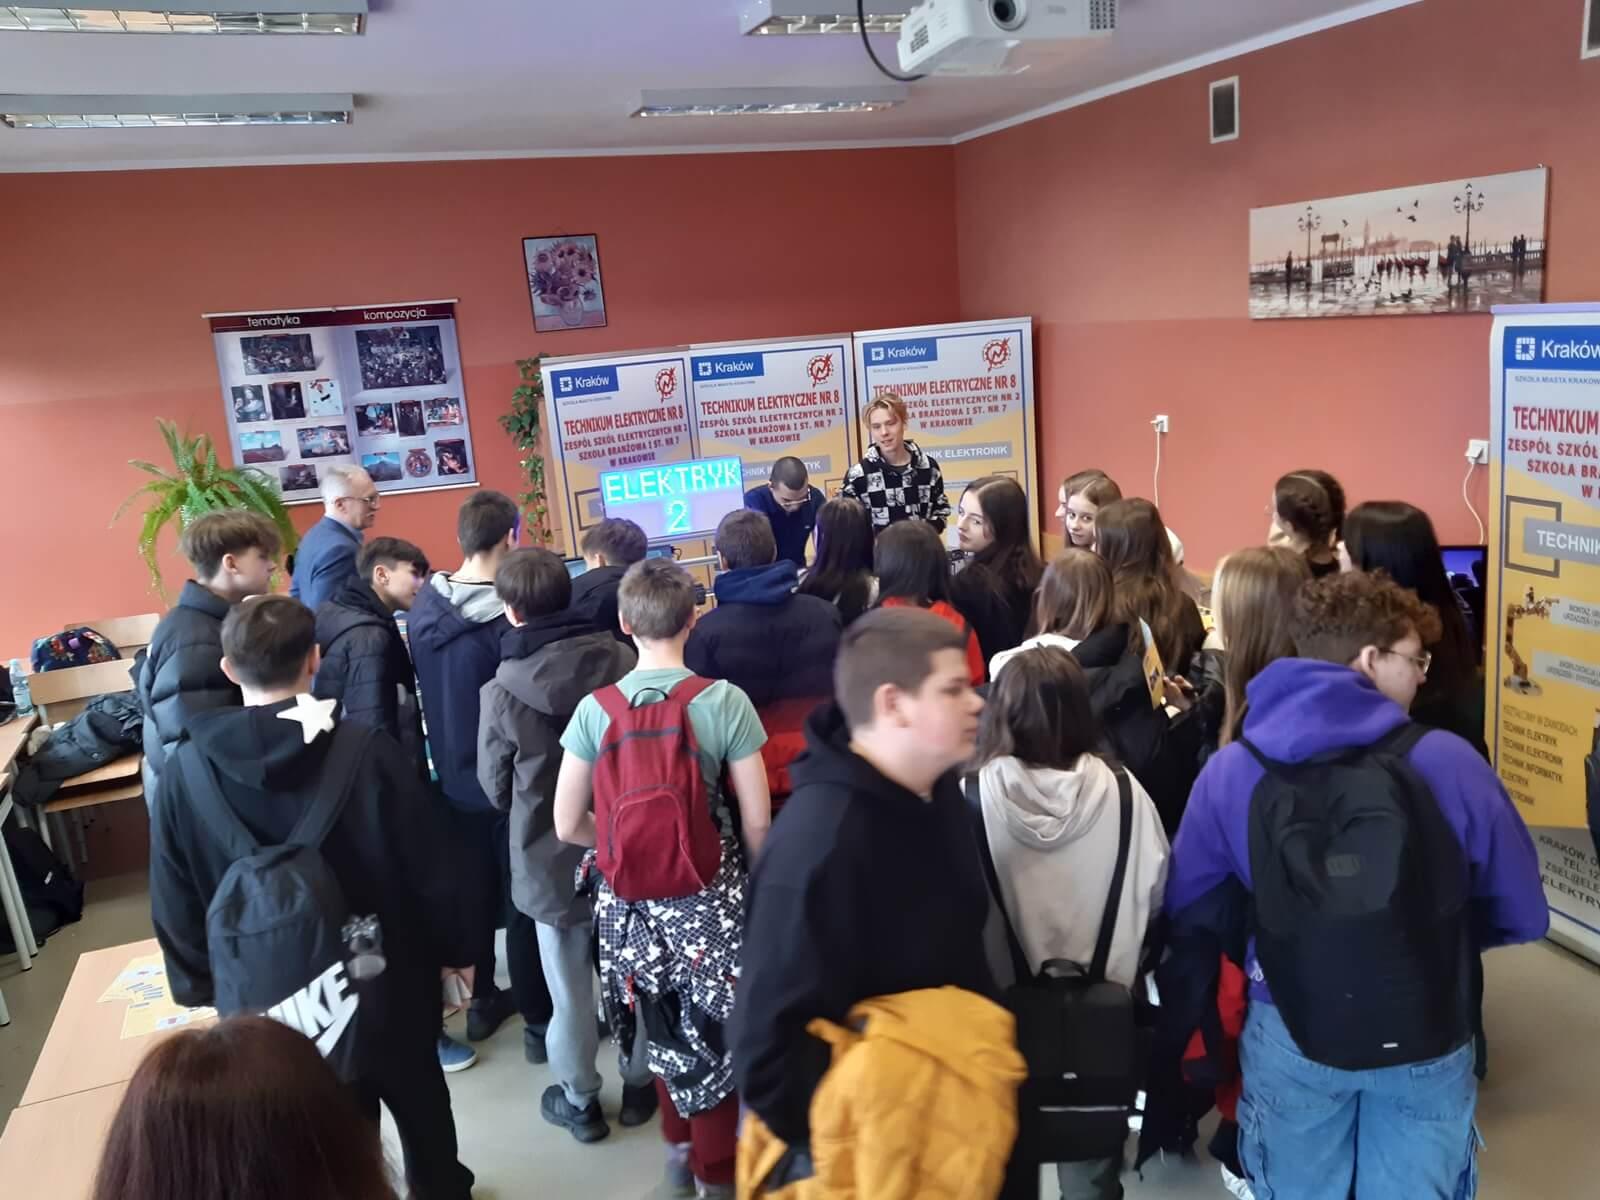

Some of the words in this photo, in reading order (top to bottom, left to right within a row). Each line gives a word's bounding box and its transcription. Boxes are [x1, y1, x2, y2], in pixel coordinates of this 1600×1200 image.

[247, 315, 301, 328] tematyka
[363, 308, 427, 321] kompozycja
[888, 346, 927, 358] Kraków
[715, 361, 754, 373] Kraków
[575, 375, 609, 389] Kraków
[873, 382, 927, 398] TECHNIKUM
[929, 377, 992, 394] ELEKTRYCZNE
[994, 375, 1008, 389] NR
[1010, 374, 1016, 388] 8
[701, 398, 755, 415] TECHNIKUM
[757, 392, 817, 410] ELEKTRYCZNE
[820, 391, 832, 404] NR
[834, 390, 840, 403] 8
[931, 395, 998, 407] ELEKTRYCZNYCH
[1001, 393, 1012, 401] NR
[988, 405, 999, 413] NR
[1002, 404, 1007, 412] 7
[564, 415, 613, 436] TECHNIKUM
[615, 407, 666, 429] ELEKTRYCZNE
[667, 406, 677, 420] NR
[679, 404, 684, 419] 8
[699, 417, 730, 429] ZESPÓŁ
[732, 415, 756, 426] SZKÓŁ
[760, 410, 823, 423] ELEKTRYCZNYCH
[826, 409, 836, 417] NR
[920, 421, 927, 429] W
[930, 417, 973, 428] KRAKOWIE
[1513, 406, 1598, 435] TECHNIKUM
[714, 427, 745, 439] SZKOŁA
[814, 419, 825, 428] NR
[564, 437, 592, 451] ZESPÓŁ
[618, 426, 671, 442] ELEKTRYCZNYCH
[673, 424, 682, 433] NR
[749, 437, 756, 445] W
[759, 433, 801, 444] KRAKOWIE
[944, 446, 1008, 458] ELEKTRONIK
[1508, 436, 1552, 455] ZESPÓŁ
[1557, 440, 1598, 459] SZKÓŁ
[619, 452, 655, 465] KRAKOWIE
[1527, 459, 1576, 476] SZKOŁA
[1581, 464, 1600, 479] BR
[604, 461, 741, 501] ELEKTRYK
[1581, 484, 1593, 498] W
[668, 500, 690, 532] 2
[1527, 729, 1557, 746] ELEKTRYK
